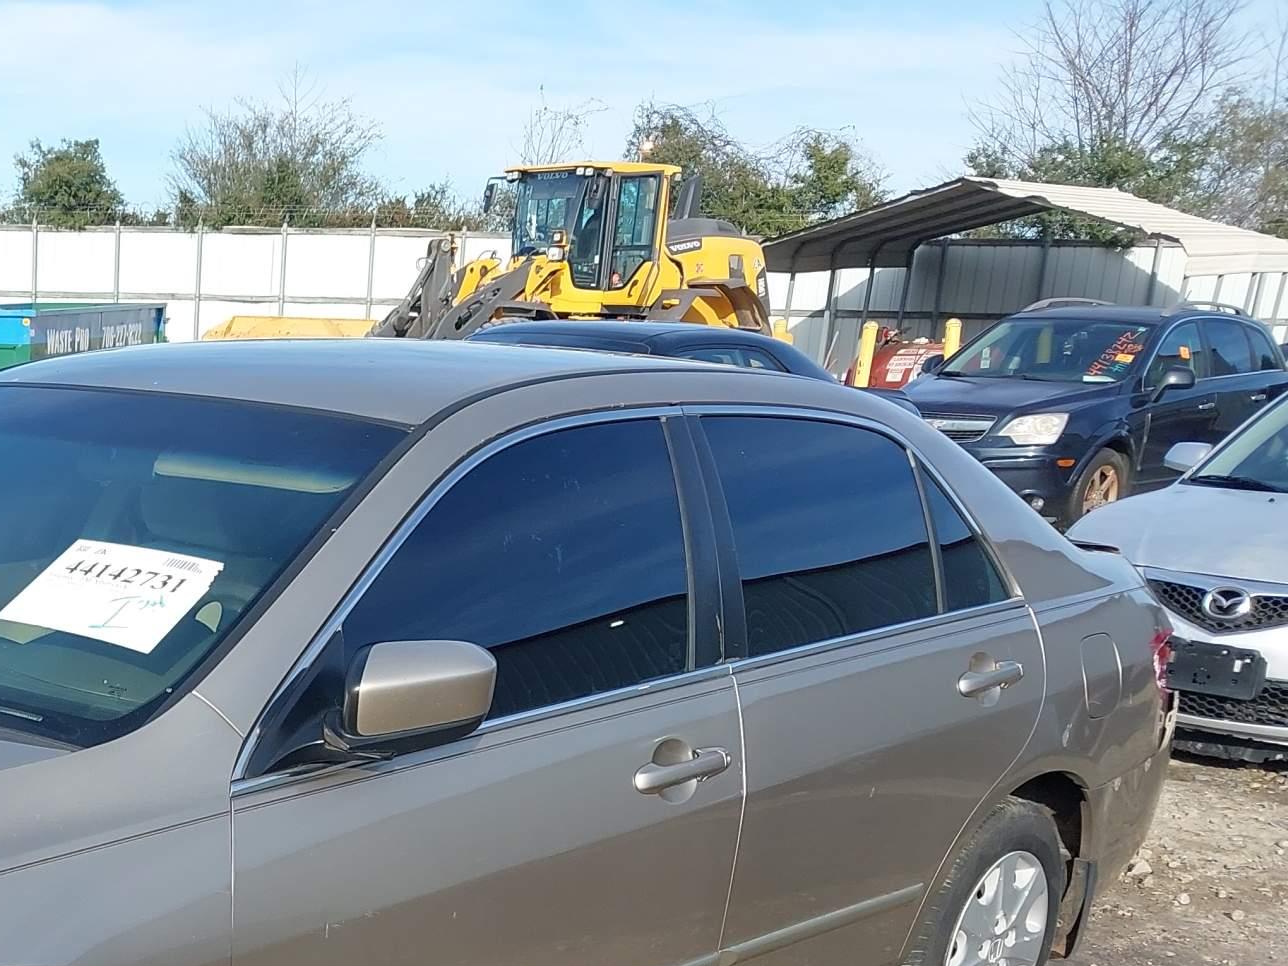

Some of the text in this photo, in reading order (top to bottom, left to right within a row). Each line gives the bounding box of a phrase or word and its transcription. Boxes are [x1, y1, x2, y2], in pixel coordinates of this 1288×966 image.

[537, 171, 569, 181] VOLVO
[669, 240, 701, 252] VOLVO
[46, 326, 90, 355] WASTE PRO
[65, 559, 187, 593] 44142731
